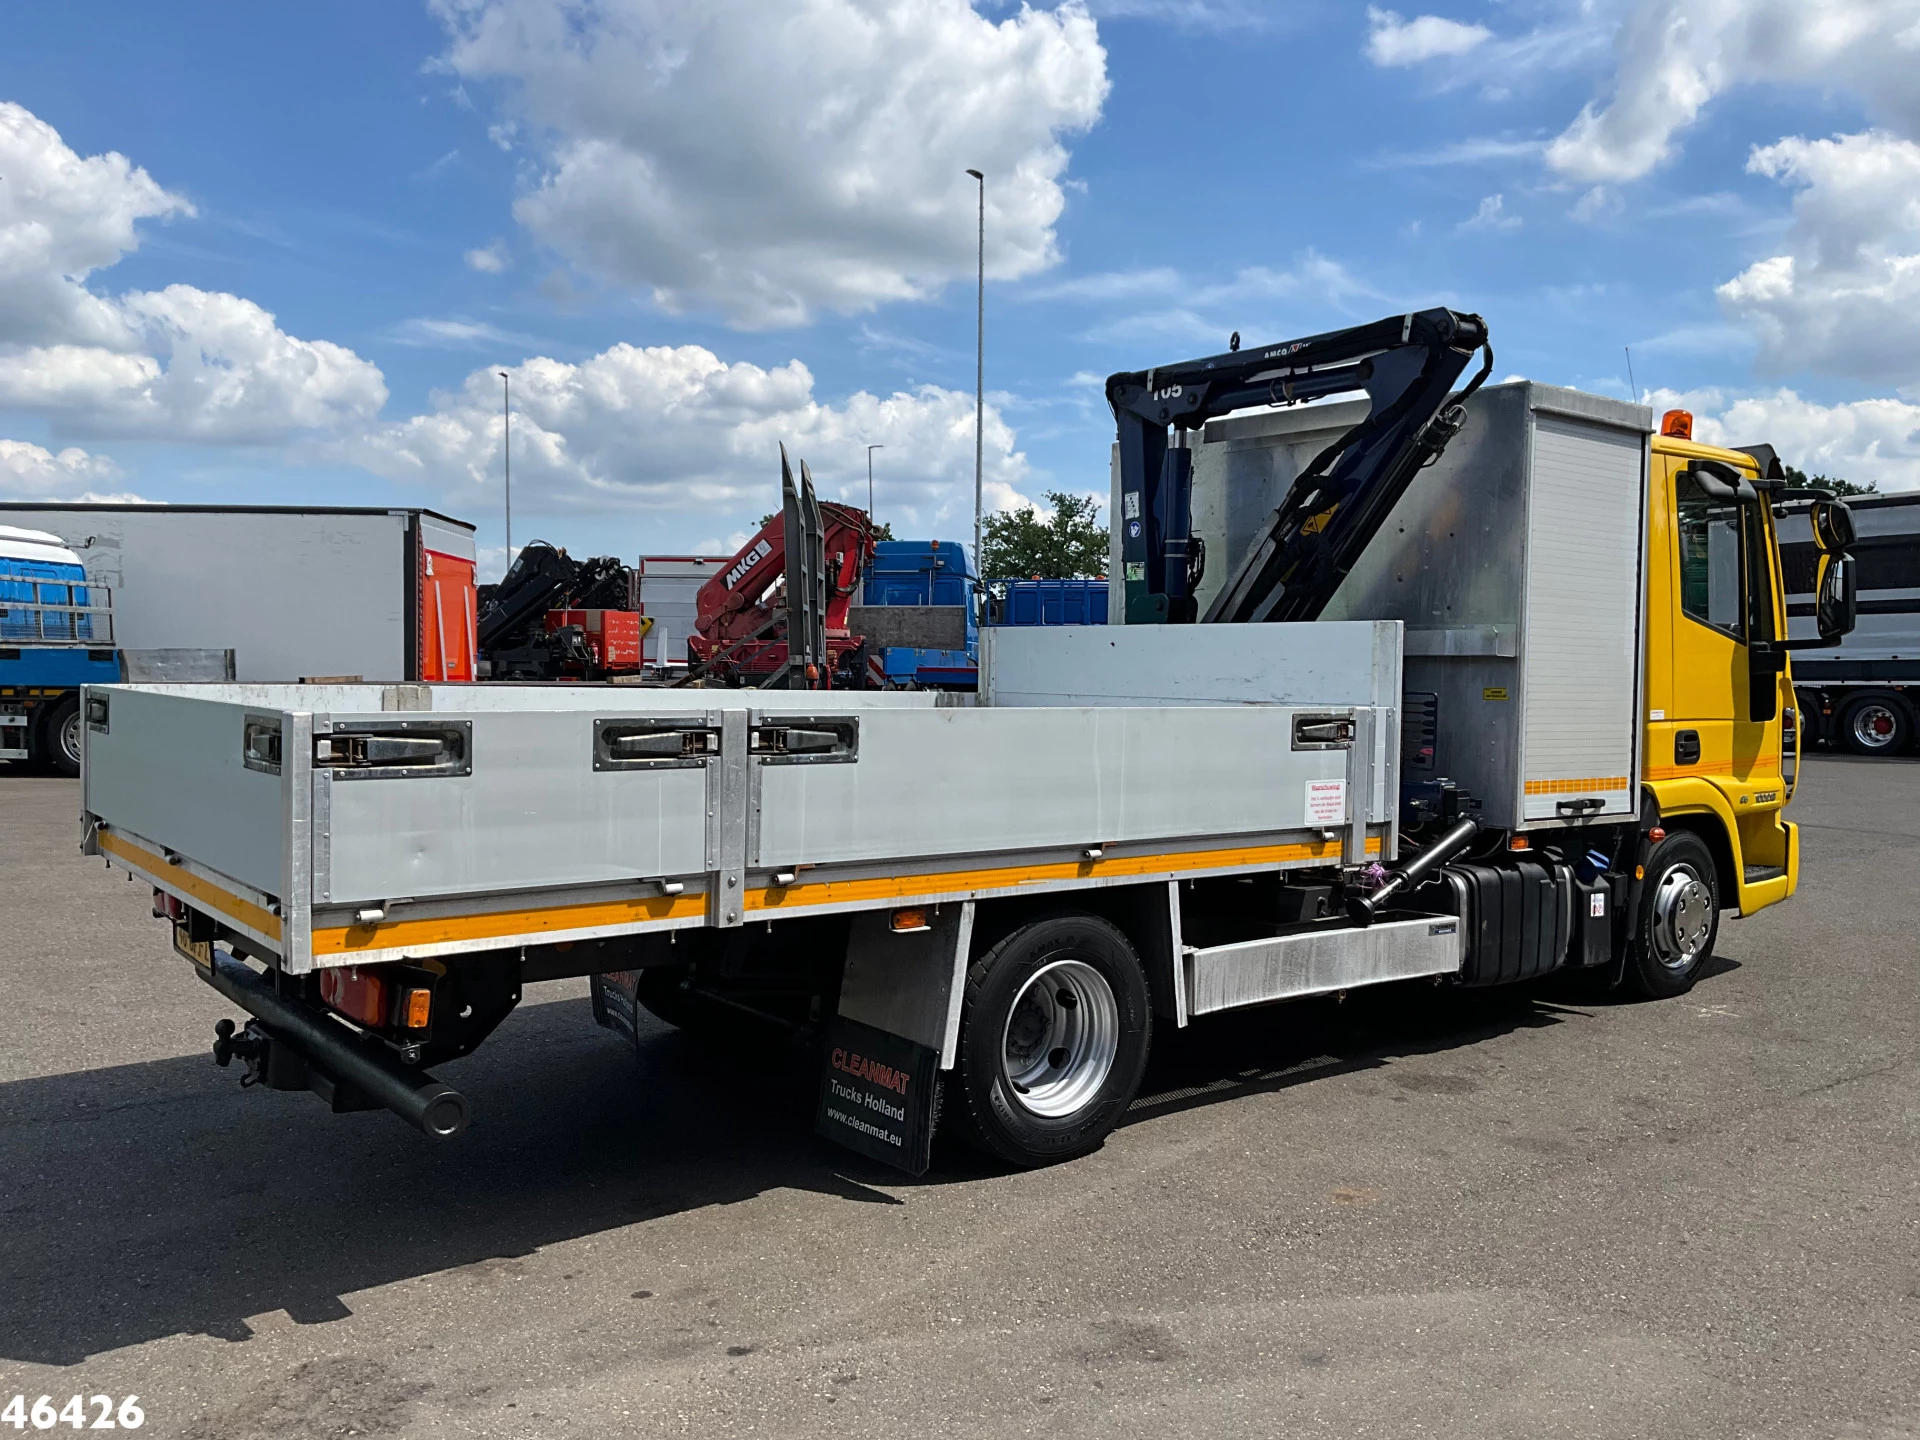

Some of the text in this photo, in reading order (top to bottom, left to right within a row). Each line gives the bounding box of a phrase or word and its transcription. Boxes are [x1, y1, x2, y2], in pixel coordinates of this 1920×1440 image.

[726, 550, 760, 590] MKG
[831, 1047, 911, 1095] CLEANMAT
[831, 1079, 905, 1122] Trucks Holland
[827, 1107, 902, 1147] www.cleanmat.eu
